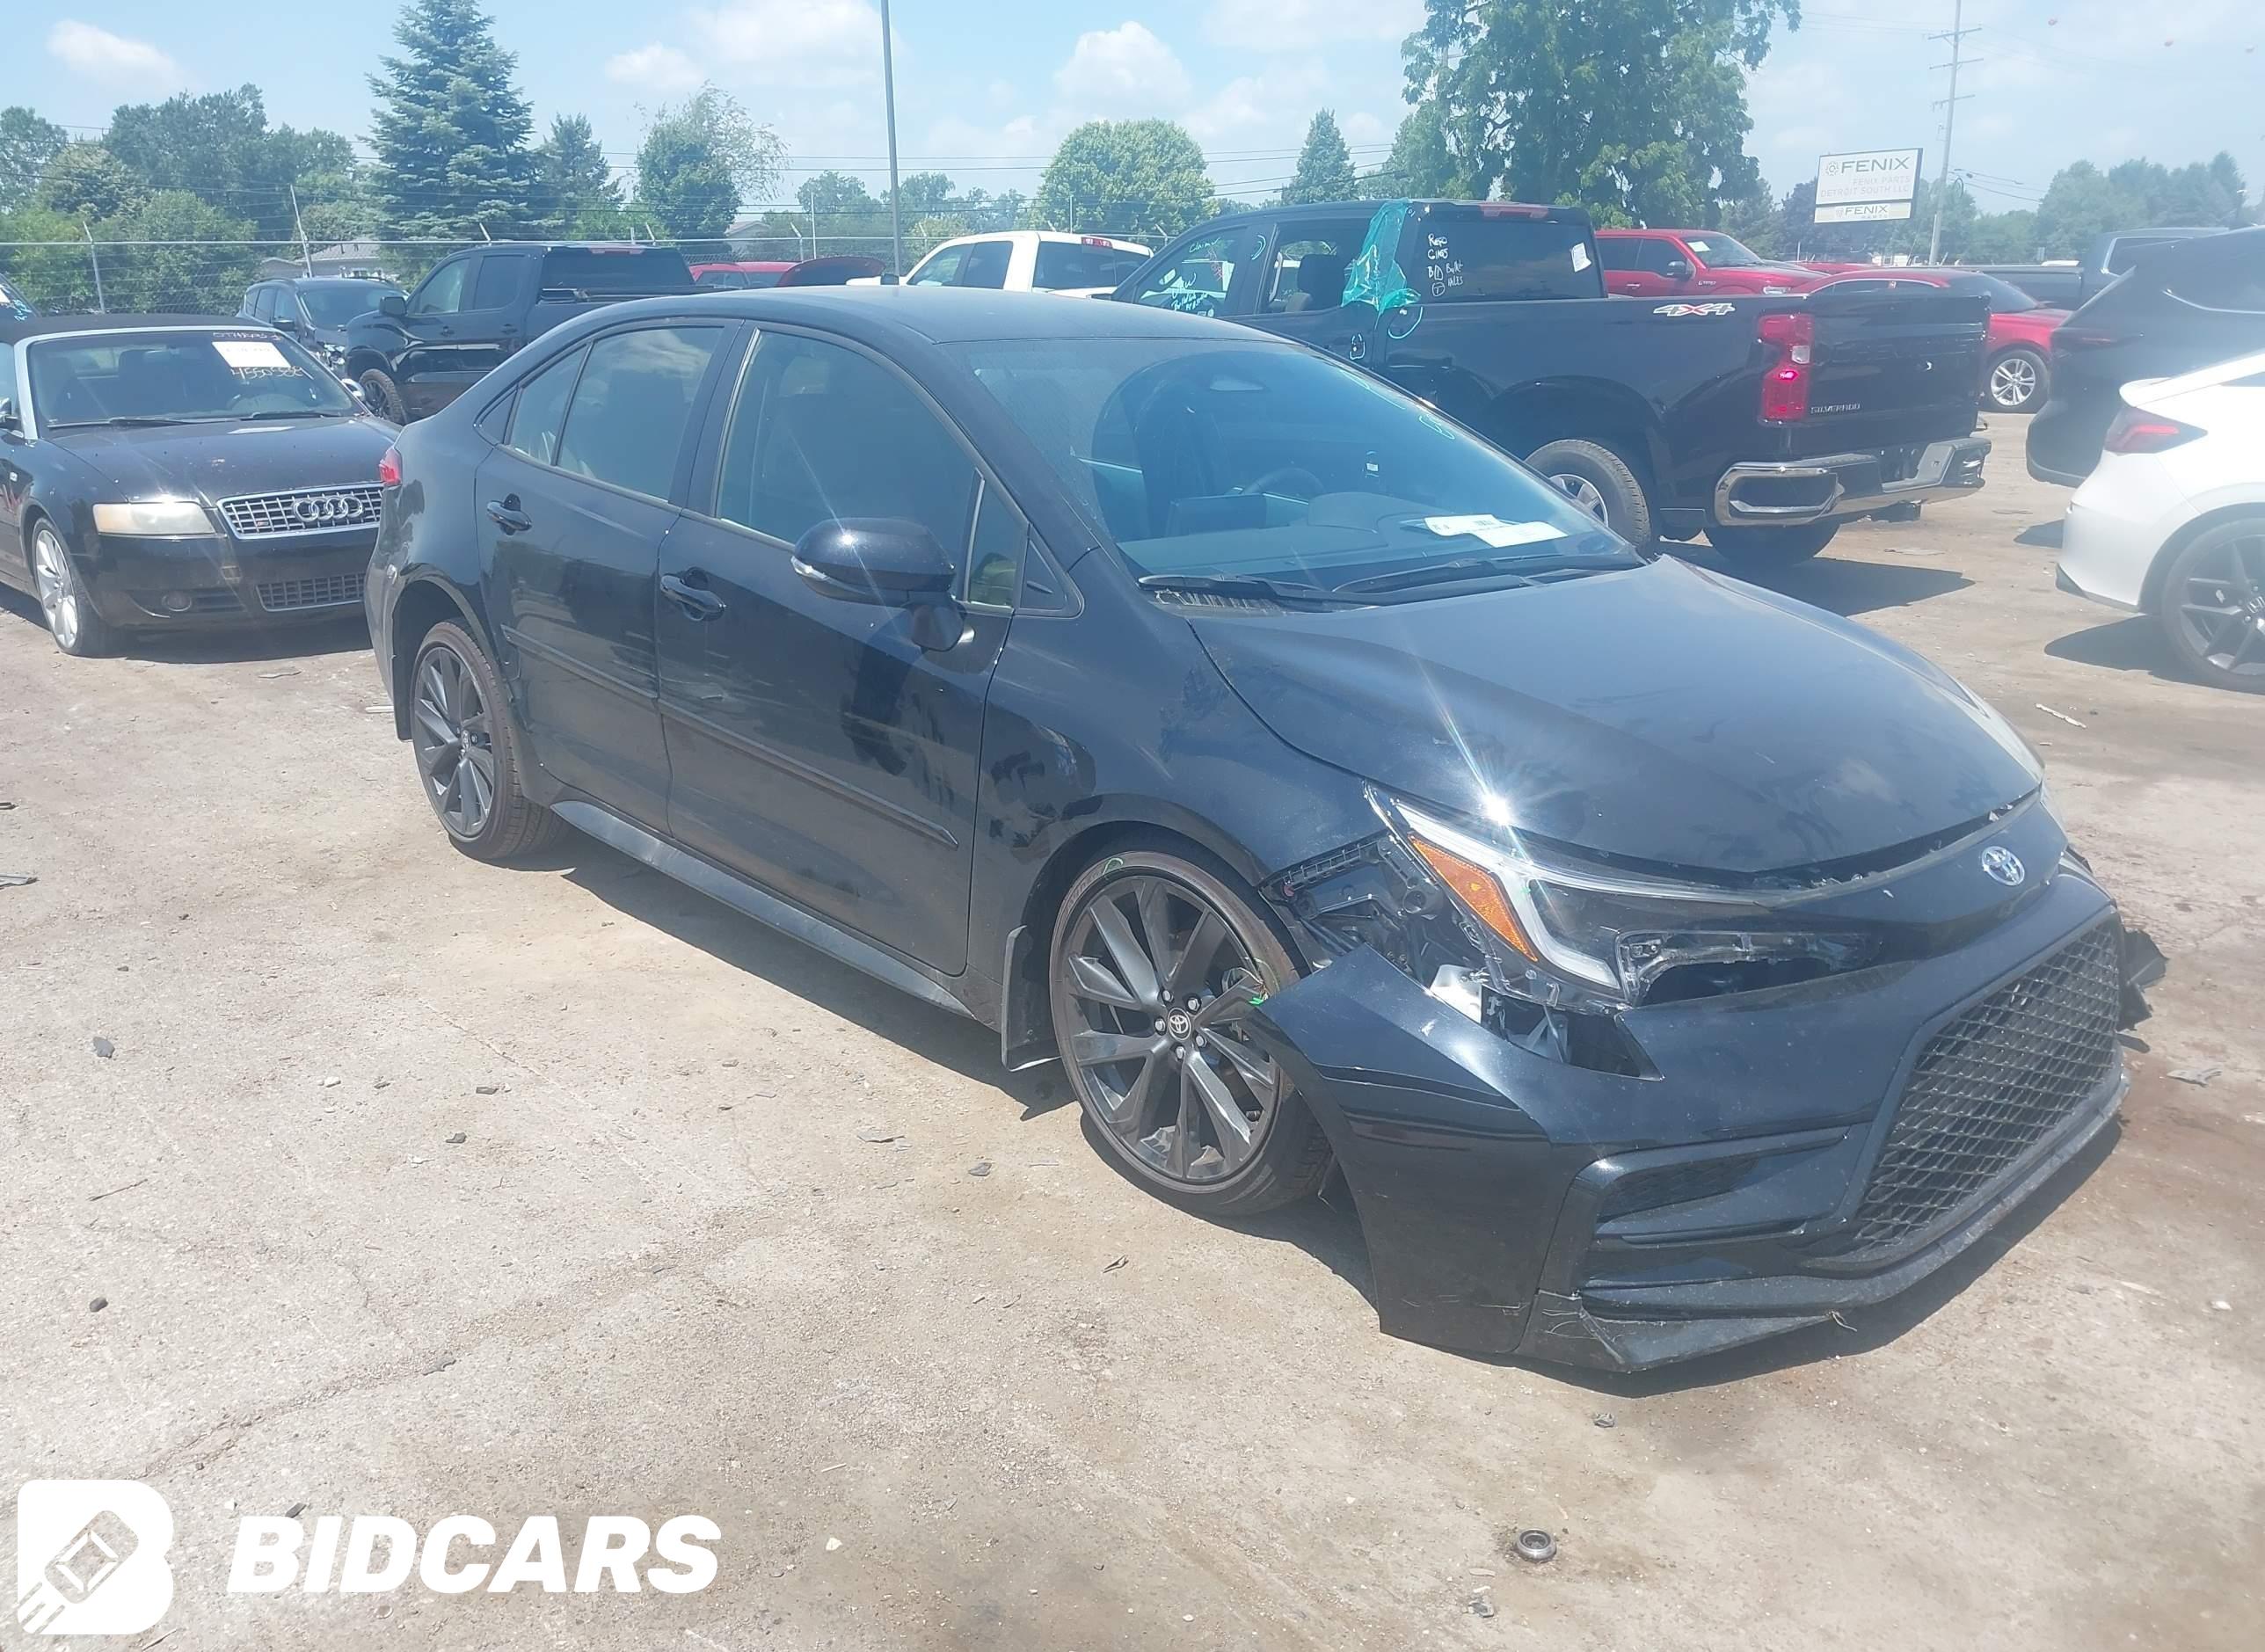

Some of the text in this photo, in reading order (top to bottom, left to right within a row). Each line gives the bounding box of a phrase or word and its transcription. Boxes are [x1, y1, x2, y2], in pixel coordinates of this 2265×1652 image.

[1841, 156, 1911, 174] FENIX
[1853, 177, 1878, 186] FENIX
[1821, 187, 1858, 198] DETROIT
[1861, 186, 1890, 195] SOUTH
[1845, 205, 1889, 215] FENIX
[1810, 404, 1861, 413] SILVERADO
